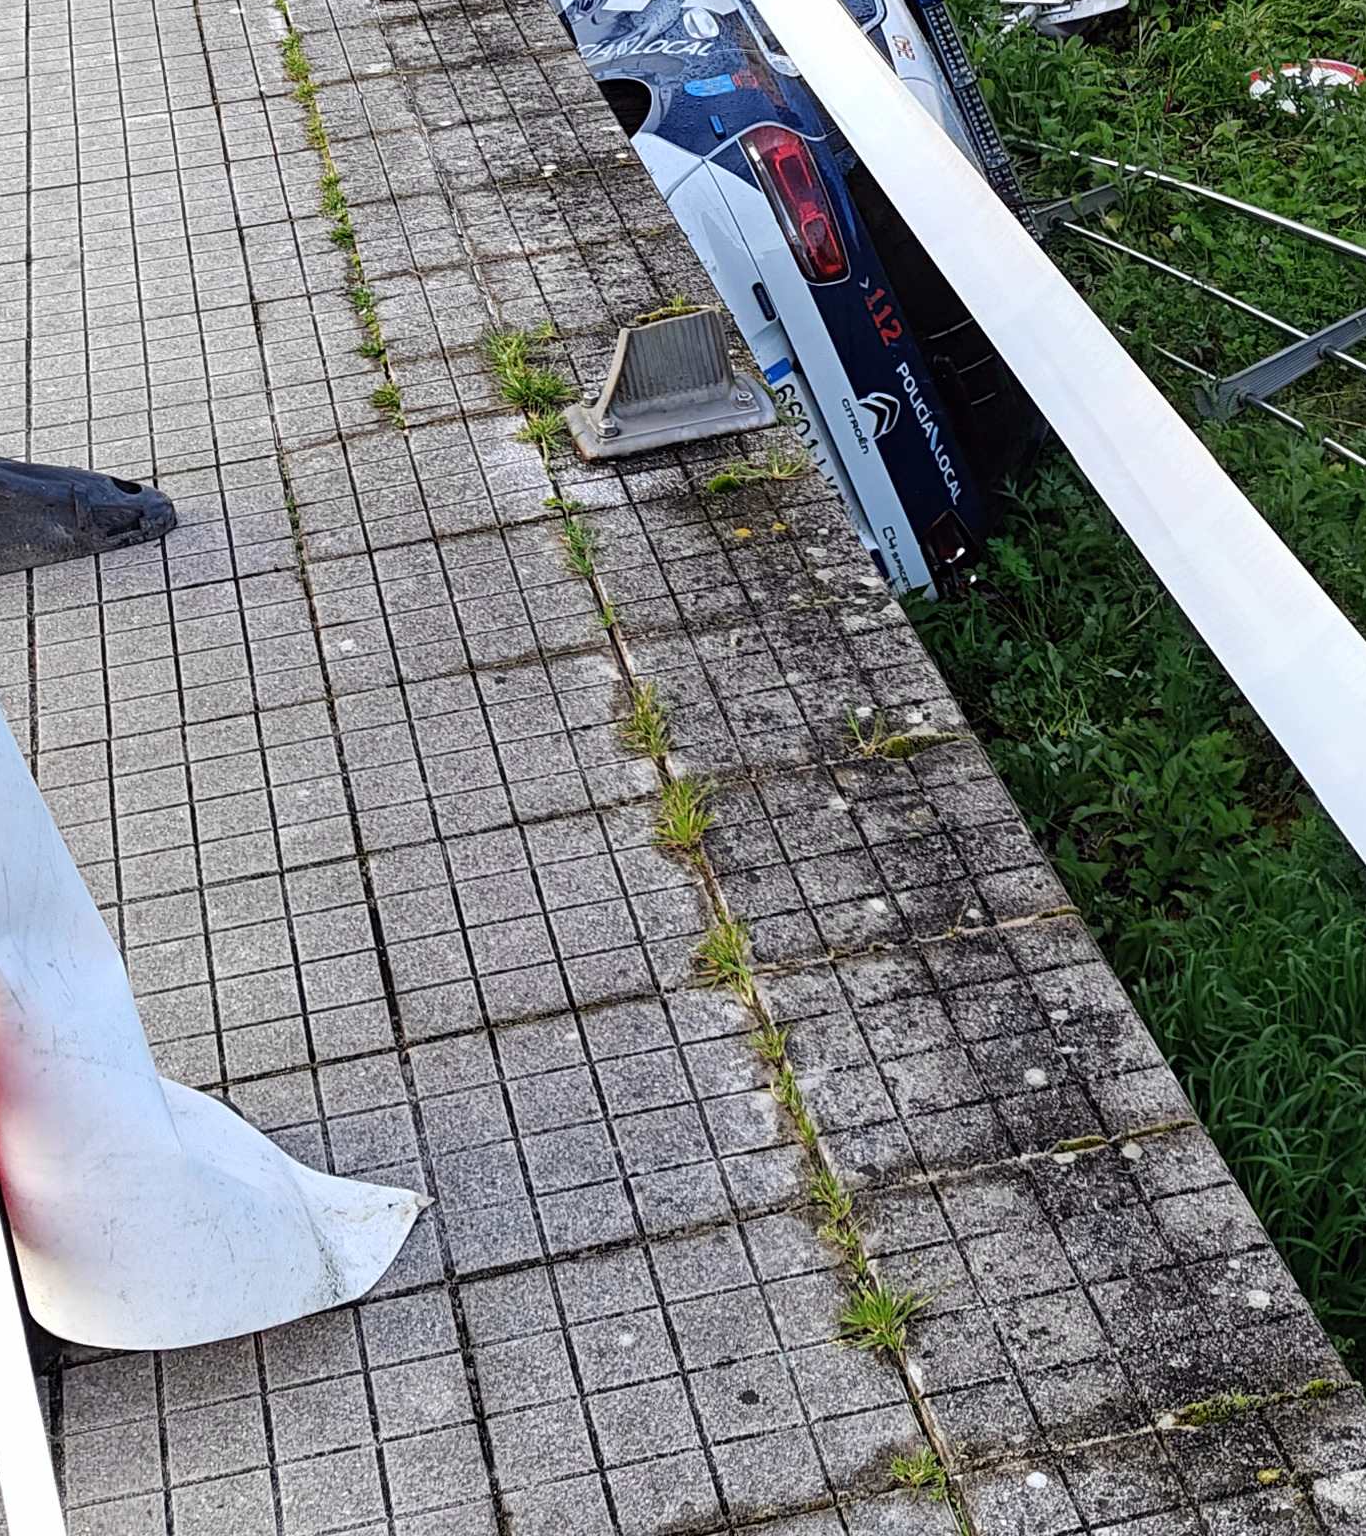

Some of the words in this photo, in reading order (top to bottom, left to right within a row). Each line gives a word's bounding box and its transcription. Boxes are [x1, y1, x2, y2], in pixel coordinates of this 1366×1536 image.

[635, 37, 715, 57] LOCAL
[864, 288, 903, 347] 112
[895, 361, 935, 438] POLICÍA
[934, 443, 962, 506] LOCAL
[882, 525, 899, 554] C4
